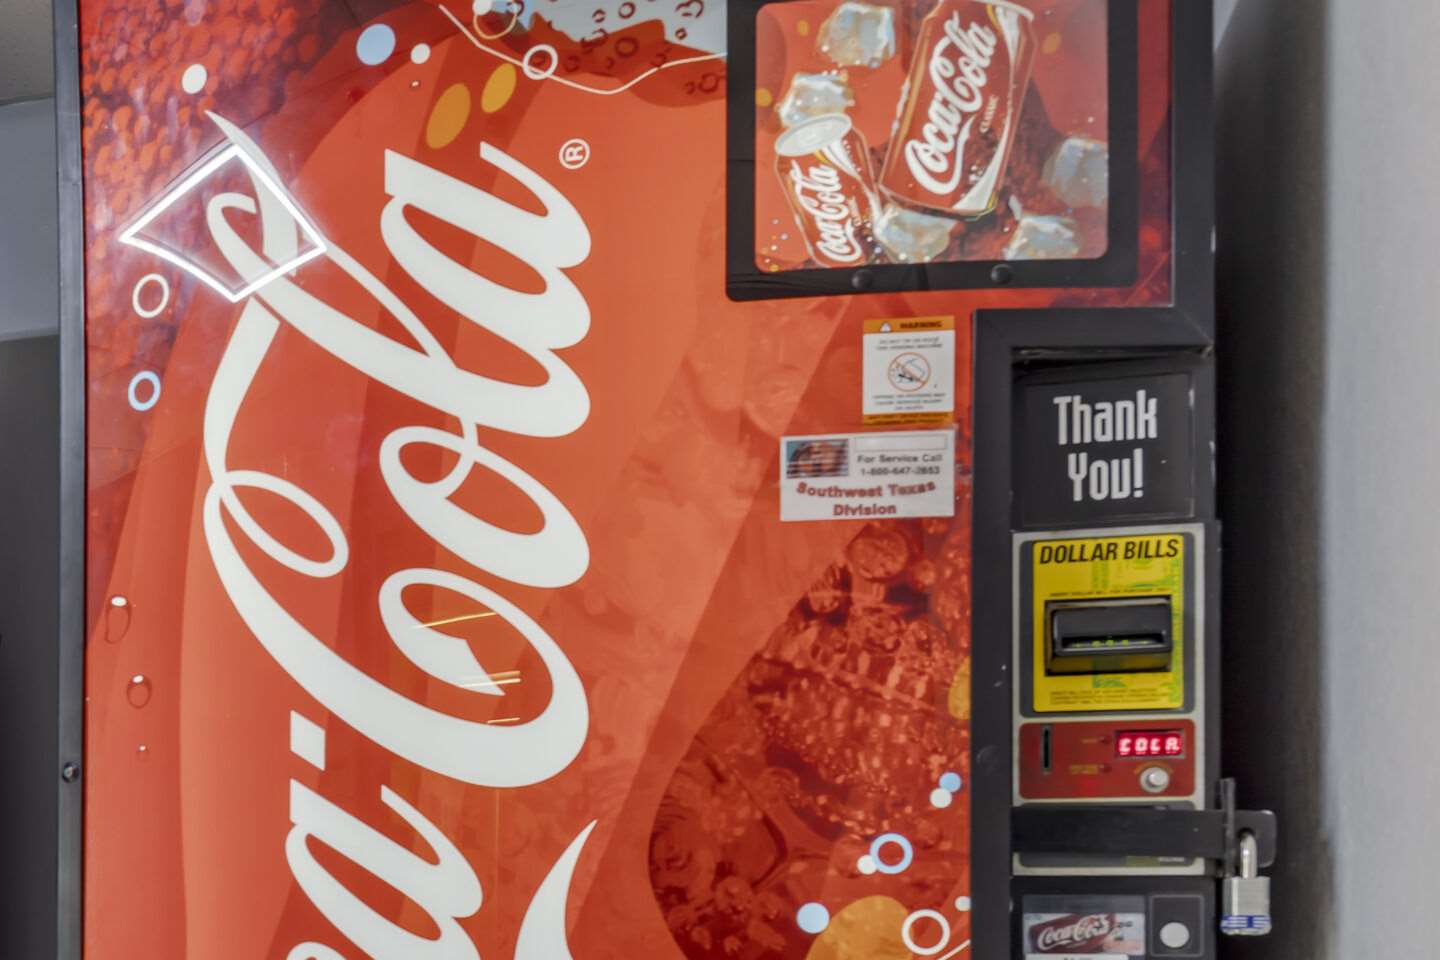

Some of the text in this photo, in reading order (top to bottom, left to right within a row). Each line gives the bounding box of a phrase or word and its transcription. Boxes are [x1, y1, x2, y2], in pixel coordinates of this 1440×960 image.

[1053, 390, 1159, 446] Thank
[857, 453, 944, 464] For Service Call
[1067, 448, 1144, 502] You!
[796, 481, 937, 498] Southwest Texas
[833, 503, 897, 516] Division
[1039, 538, 1180, 565] DOLLAR BILLS
